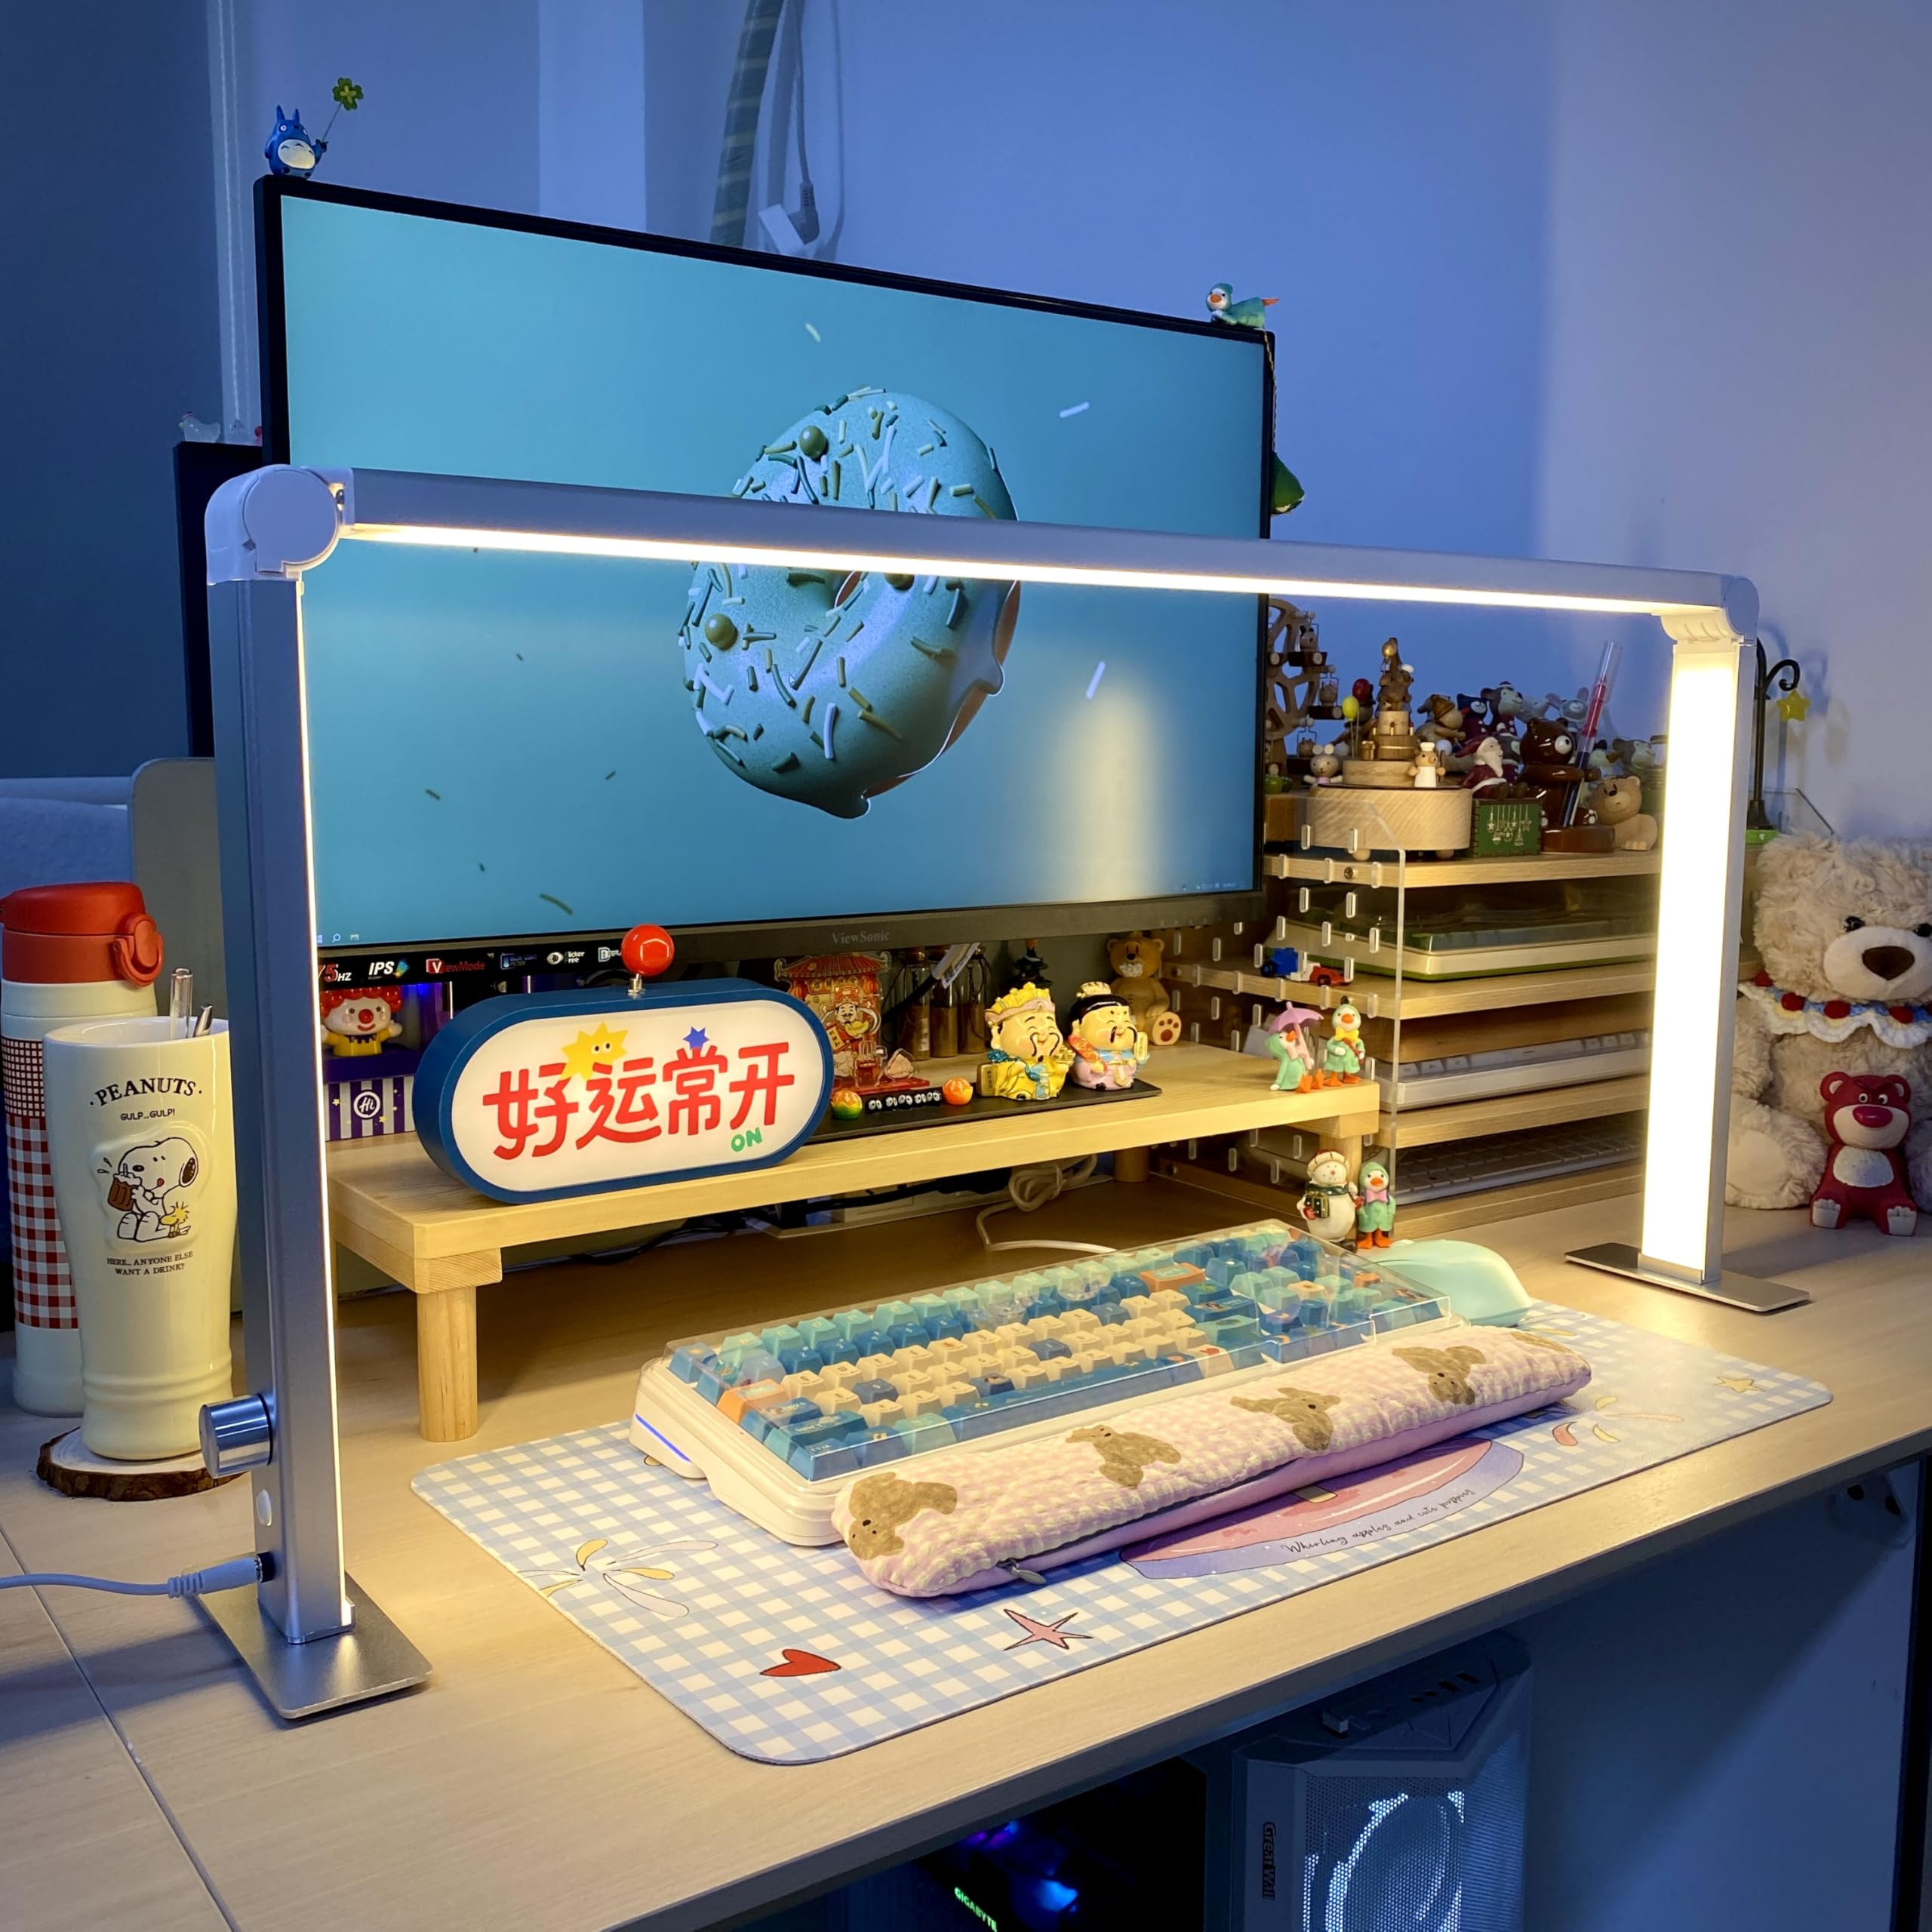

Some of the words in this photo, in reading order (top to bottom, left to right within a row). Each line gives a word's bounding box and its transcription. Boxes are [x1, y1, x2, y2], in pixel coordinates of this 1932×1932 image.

[832, 930, 891, 944] ViewSonic
[368, 961, 395, 976] IPS
[359, 1096, 375, 1113] Hi
[483, 1041, 795, 1160] 好运常开
[731, 1128, 762, 1152] ON
[134, 1256, 173, 1266] ANYONE
[174, 1251, 193, 1261] ELSE
[153, 1263, 185, 1274] DRINK?
[1281, 1535, 1349, 1553] Whirling
[1395, 1513, 1414, 1525] and
[1263, 1821, 1277, 1866] Great
[1262, 1867, 1276, 1900] Wall
[954, 1887, 998, 1932] GIGABYTE
